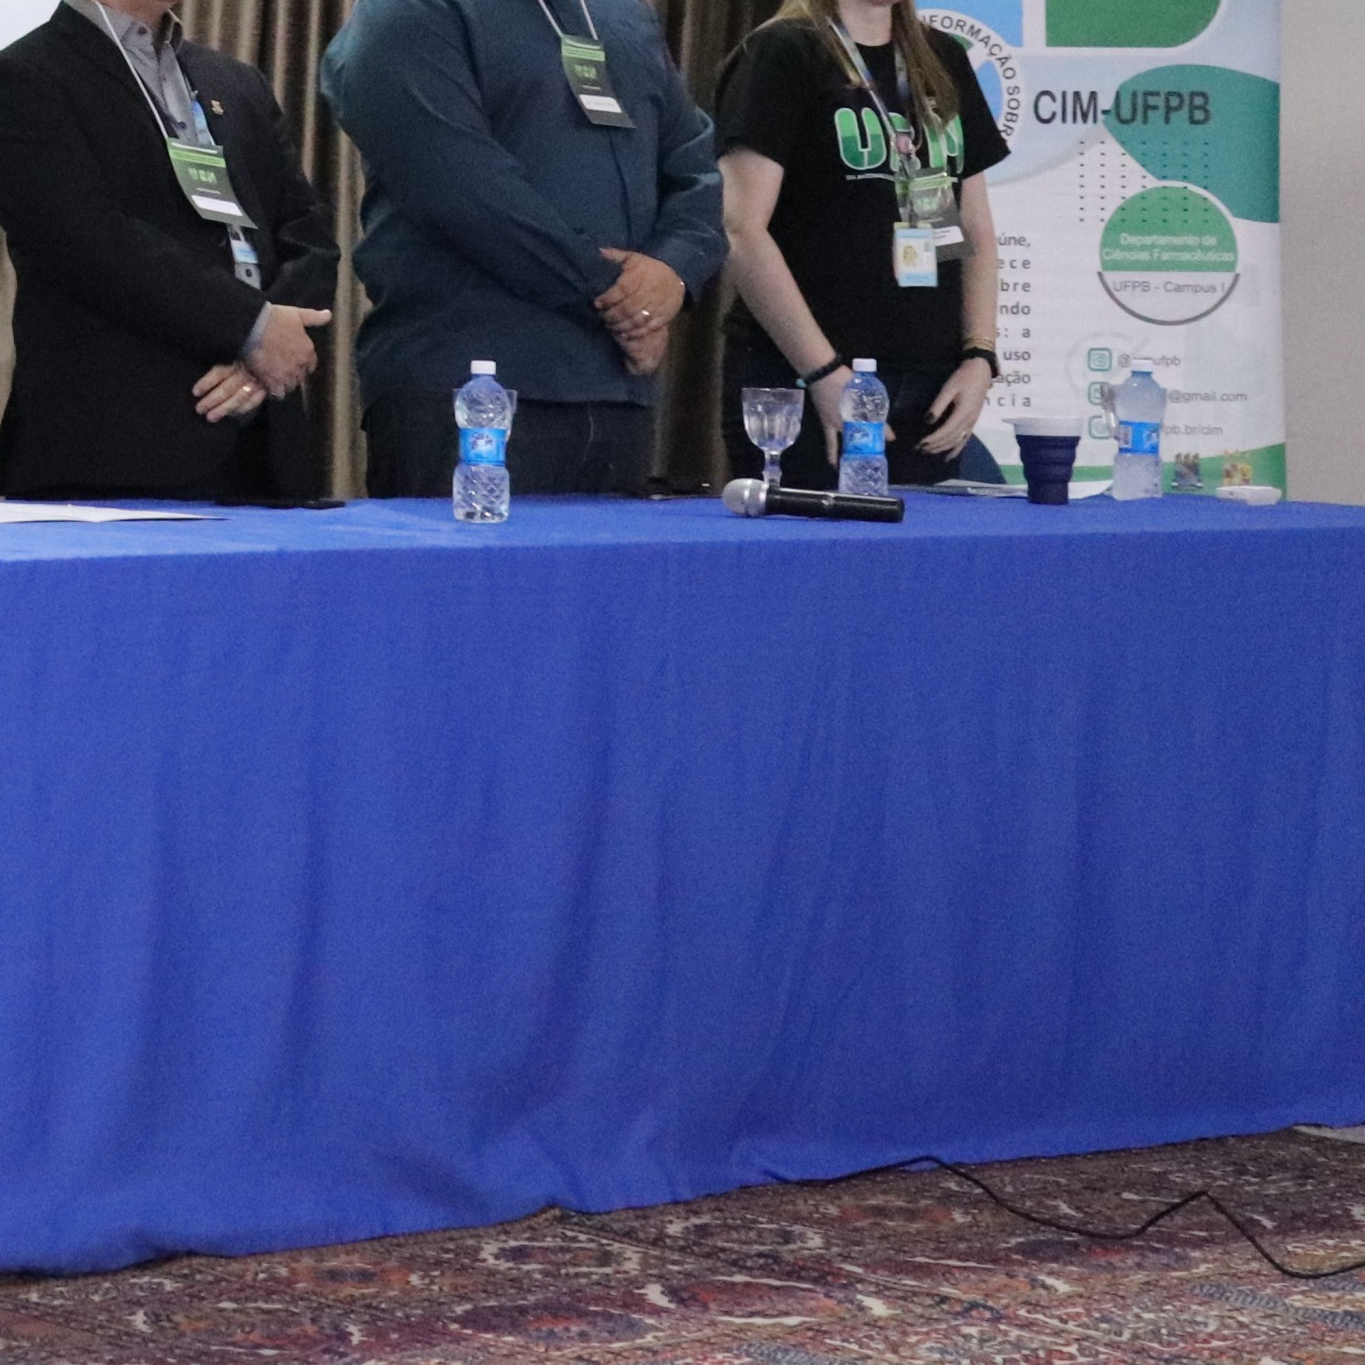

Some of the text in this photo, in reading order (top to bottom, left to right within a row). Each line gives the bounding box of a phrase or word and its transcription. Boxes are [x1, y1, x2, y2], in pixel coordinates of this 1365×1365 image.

[1000, 85, 1021, 137] SOBR
[1033, 90, 1212, 125] CIM-UFPB
[1120, 233, 1218, 248] Departamento de
[1101, 248, 1236, 263] Ciências Farmacêuticas
[1113, 281, 1151, 293] UFPB
[1163, 282, 1218, 296] Campus
[1169, 389, 1248, 405] @gmail.com
